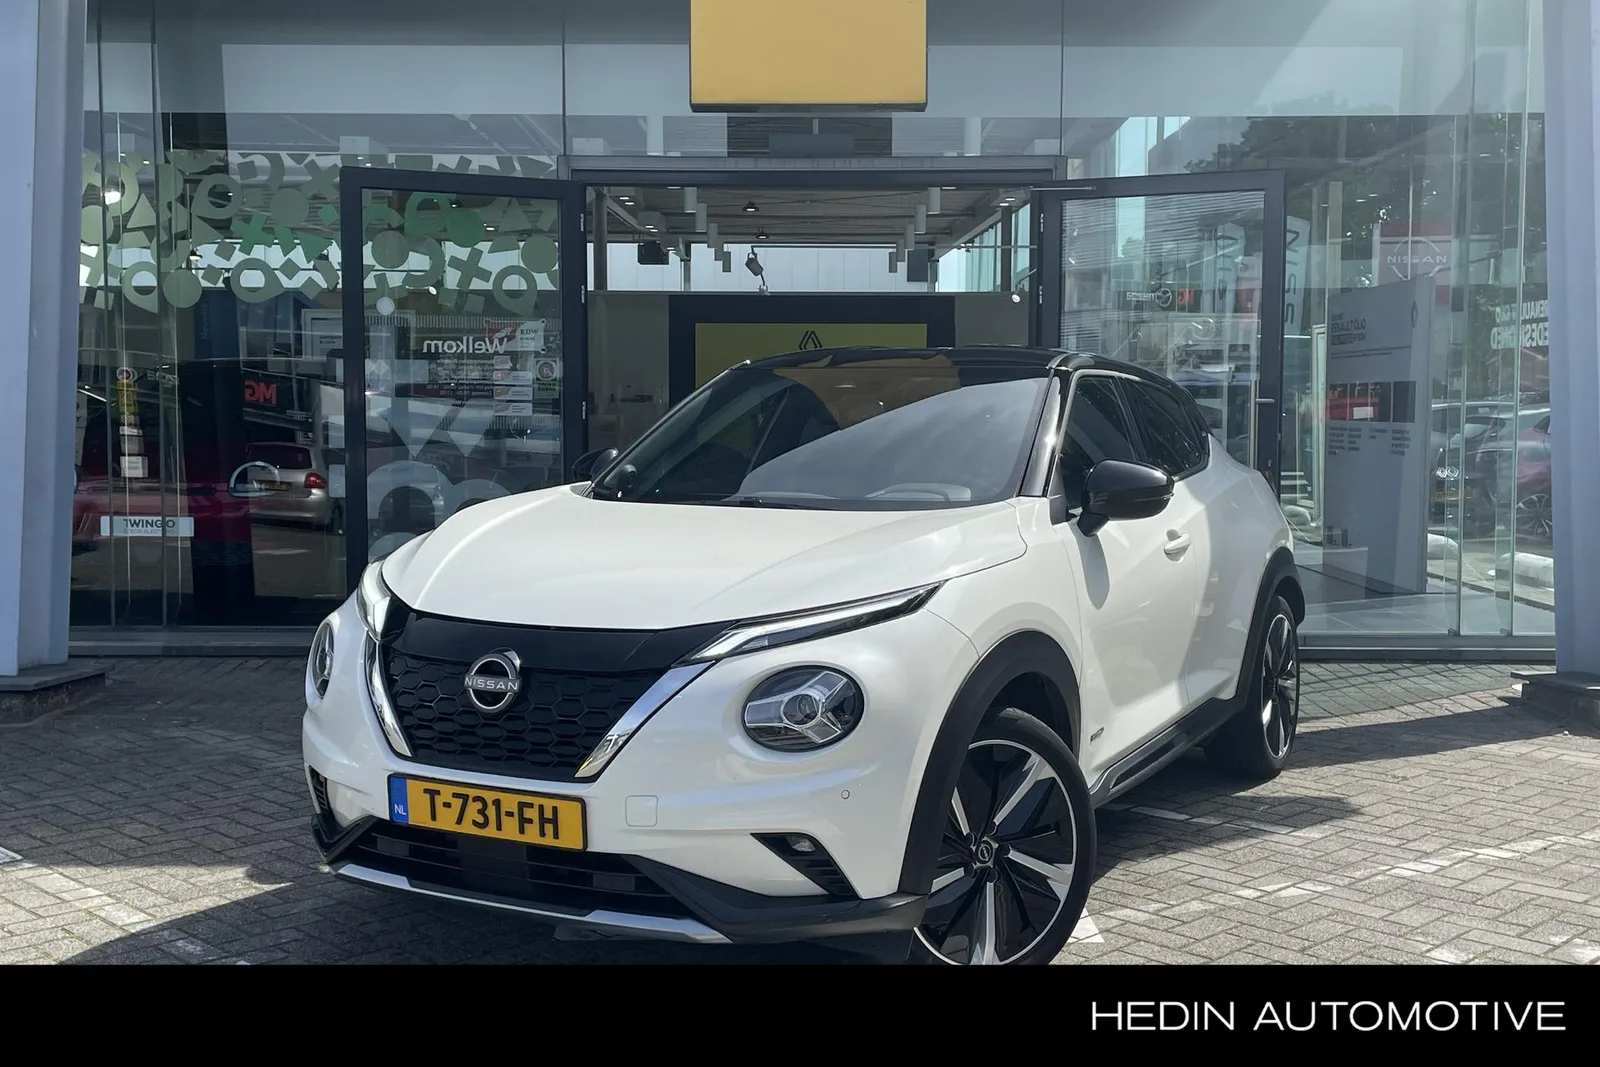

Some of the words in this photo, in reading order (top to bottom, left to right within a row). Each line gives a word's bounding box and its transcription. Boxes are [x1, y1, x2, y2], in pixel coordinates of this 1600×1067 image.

[1387, 255, 1448, 264] NISSAN
[123, 518, 176, 528] TWINGO
[465, 677, 518, 691] NISSAN
[394, 803, 407, 816] NL
[423, 788, 560, 840] T-731-FH
